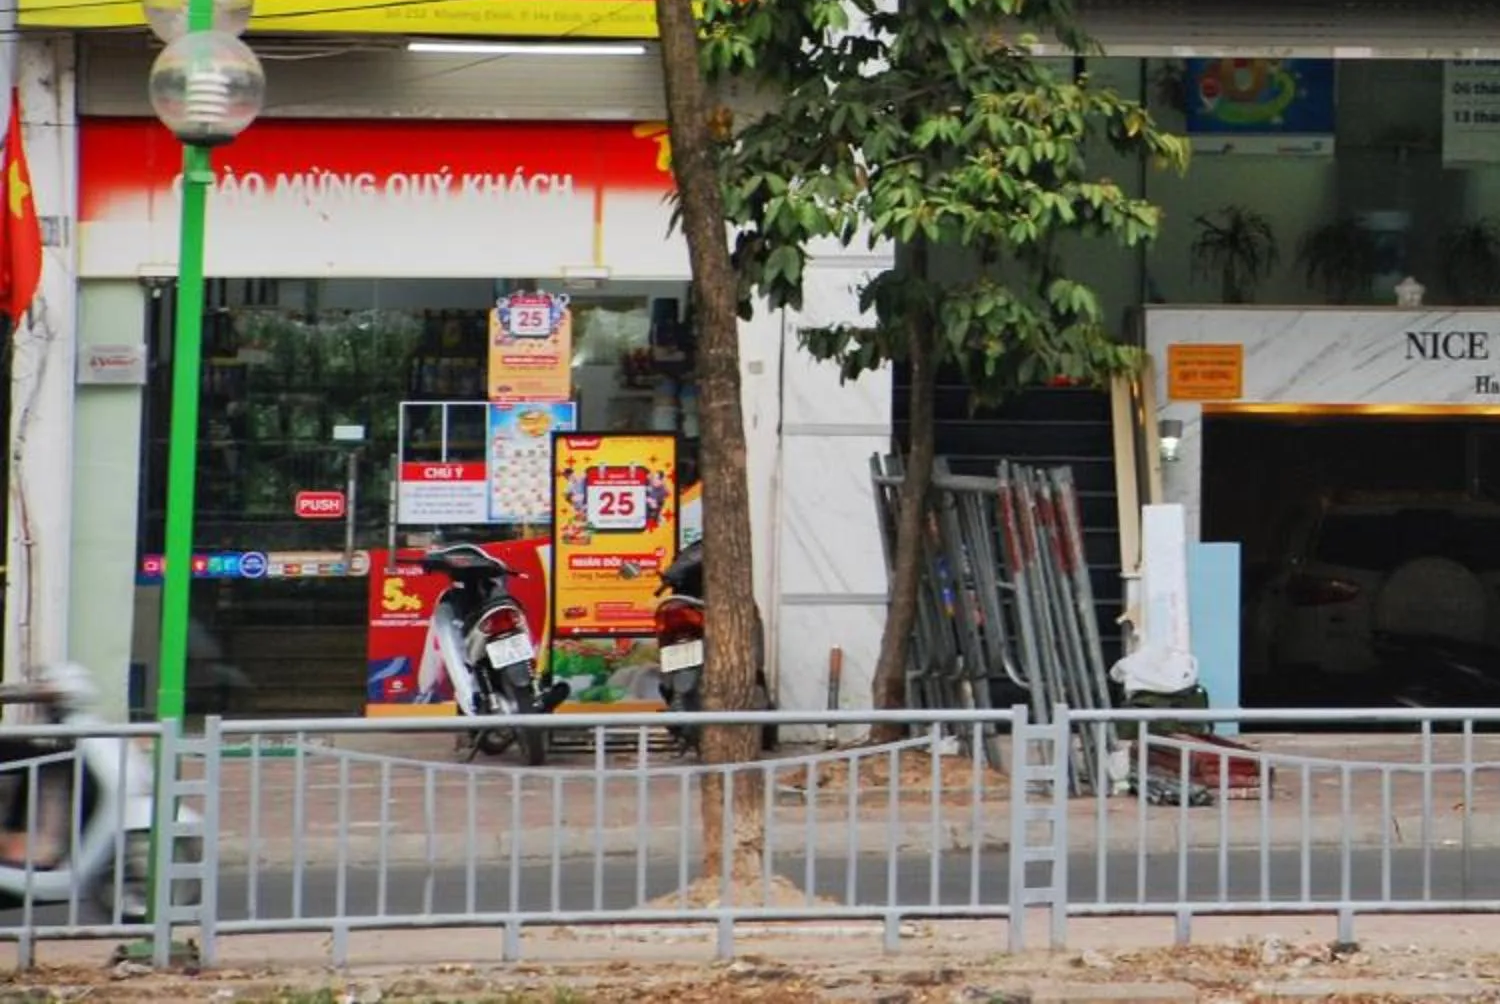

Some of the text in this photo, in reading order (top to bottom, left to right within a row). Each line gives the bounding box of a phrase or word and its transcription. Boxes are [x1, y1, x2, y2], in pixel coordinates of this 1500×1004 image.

[172, 165, 265, 200] ÀO
[517, 310, 543, 328] 25
[1404, 331, 1490, 360] NICE
[300, 498, 340, 512] PUSH
[598, 491, 635, 516] 25
[381, 576, 422, 611] 5%
